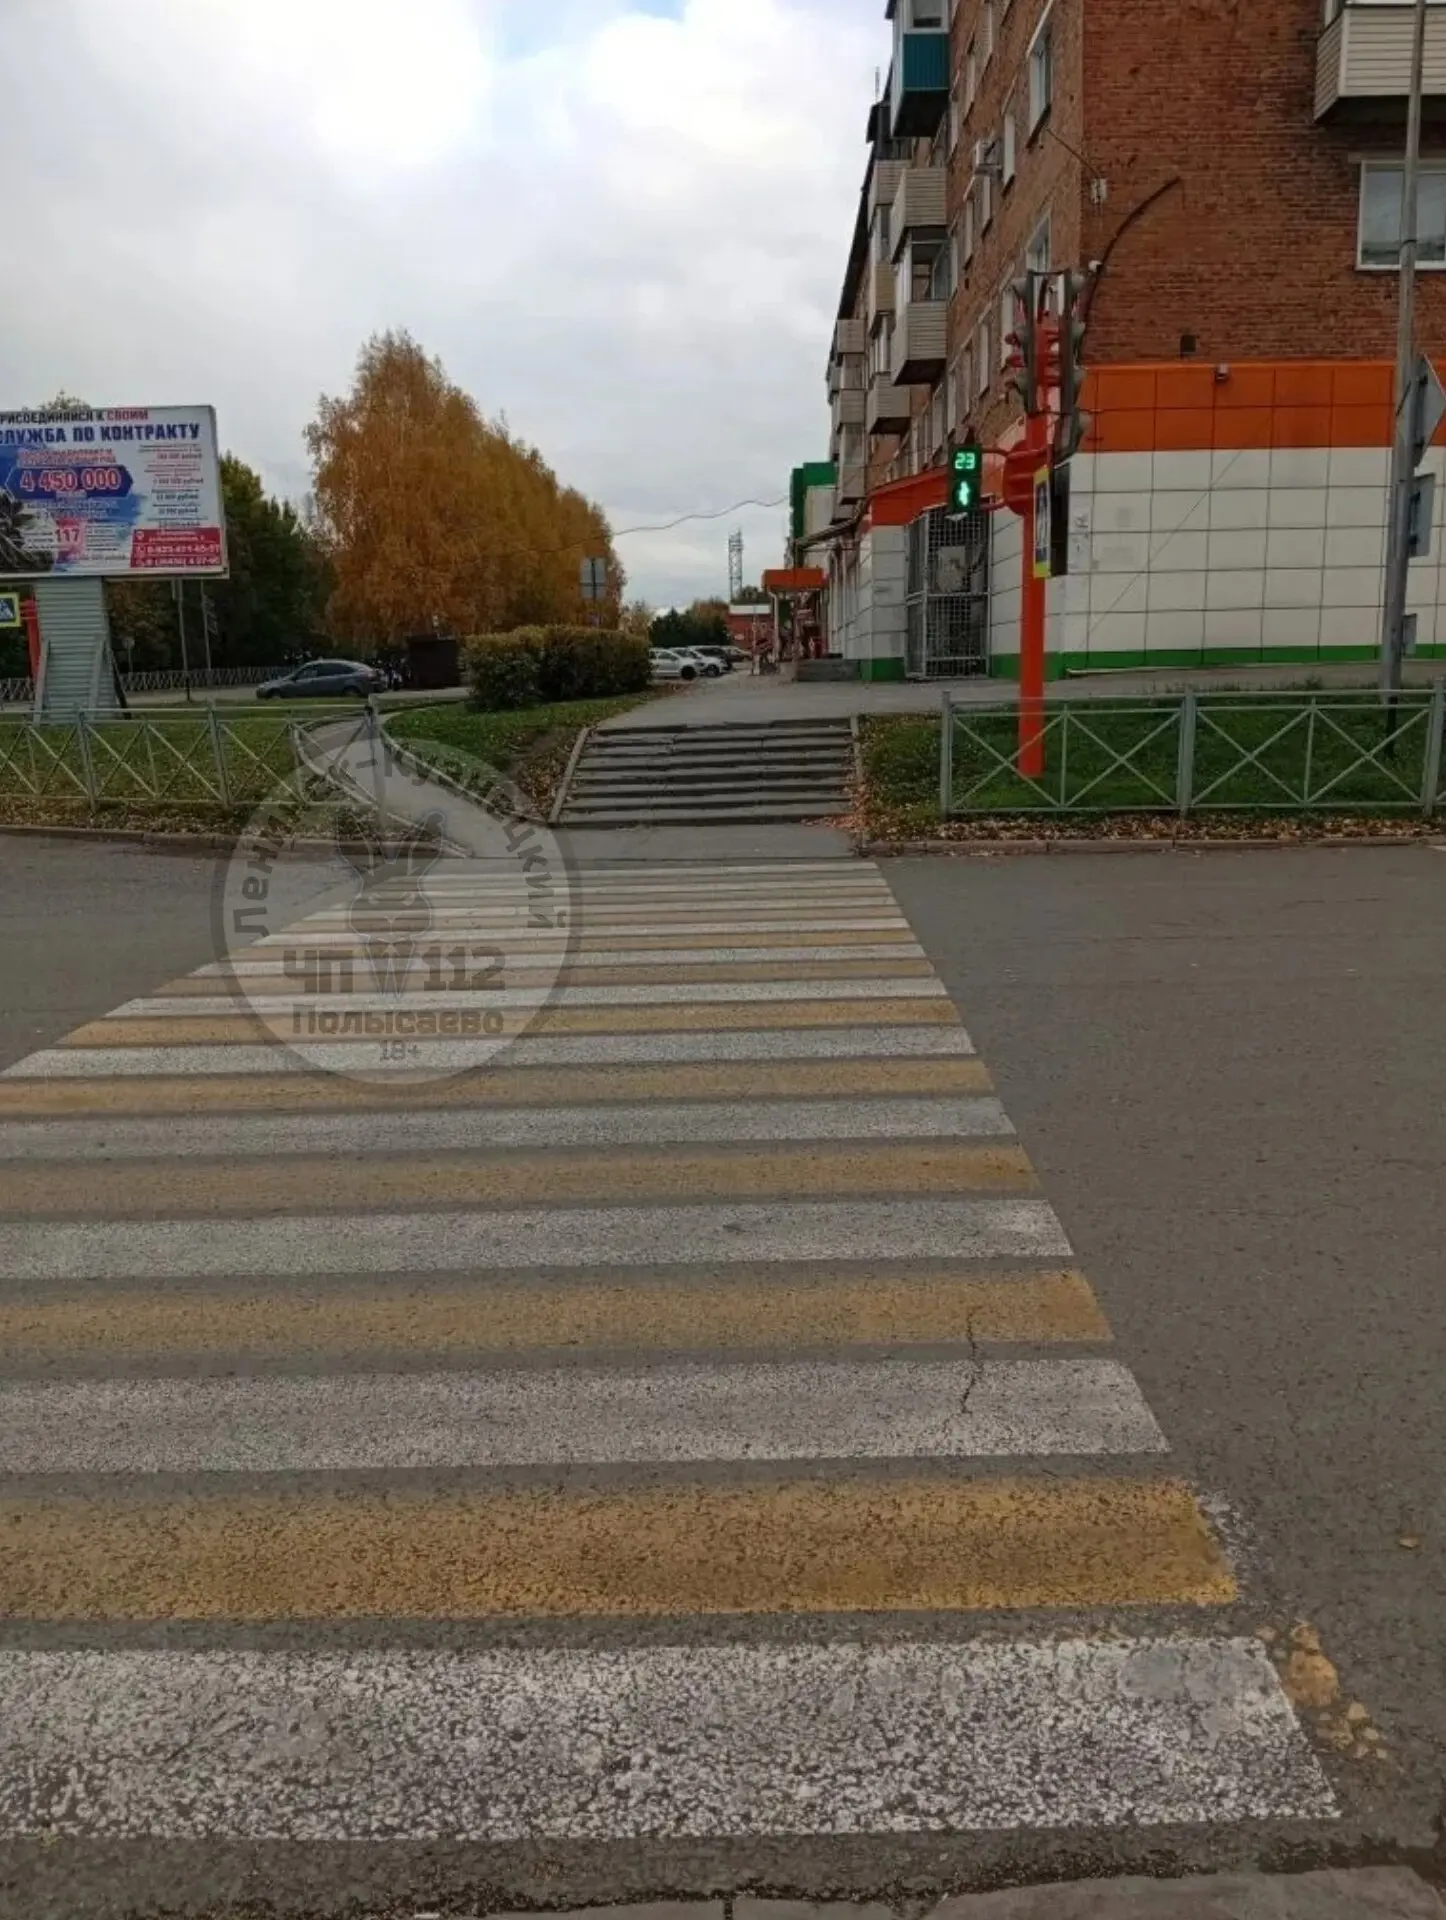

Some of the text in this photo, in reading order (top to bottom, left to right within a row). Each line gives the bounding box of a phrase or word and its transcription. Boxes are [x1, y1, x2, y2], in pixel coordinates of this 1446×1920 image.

[0, 411, 93, 425] РИСОЕДИНЯЙСЯ
[107, 409, 148, 421] СВОИМ
[72, 426, 95, 442] ПО
[101, 423, 200, 442] КОНТРАКТУ
[955, 452, 975, 469] 23
[20, 470, 35, 492] 4
[39, 469, 77, 491] 450
[82, 468, 121, 490] 000
[55, 528, 80, 542] 117
